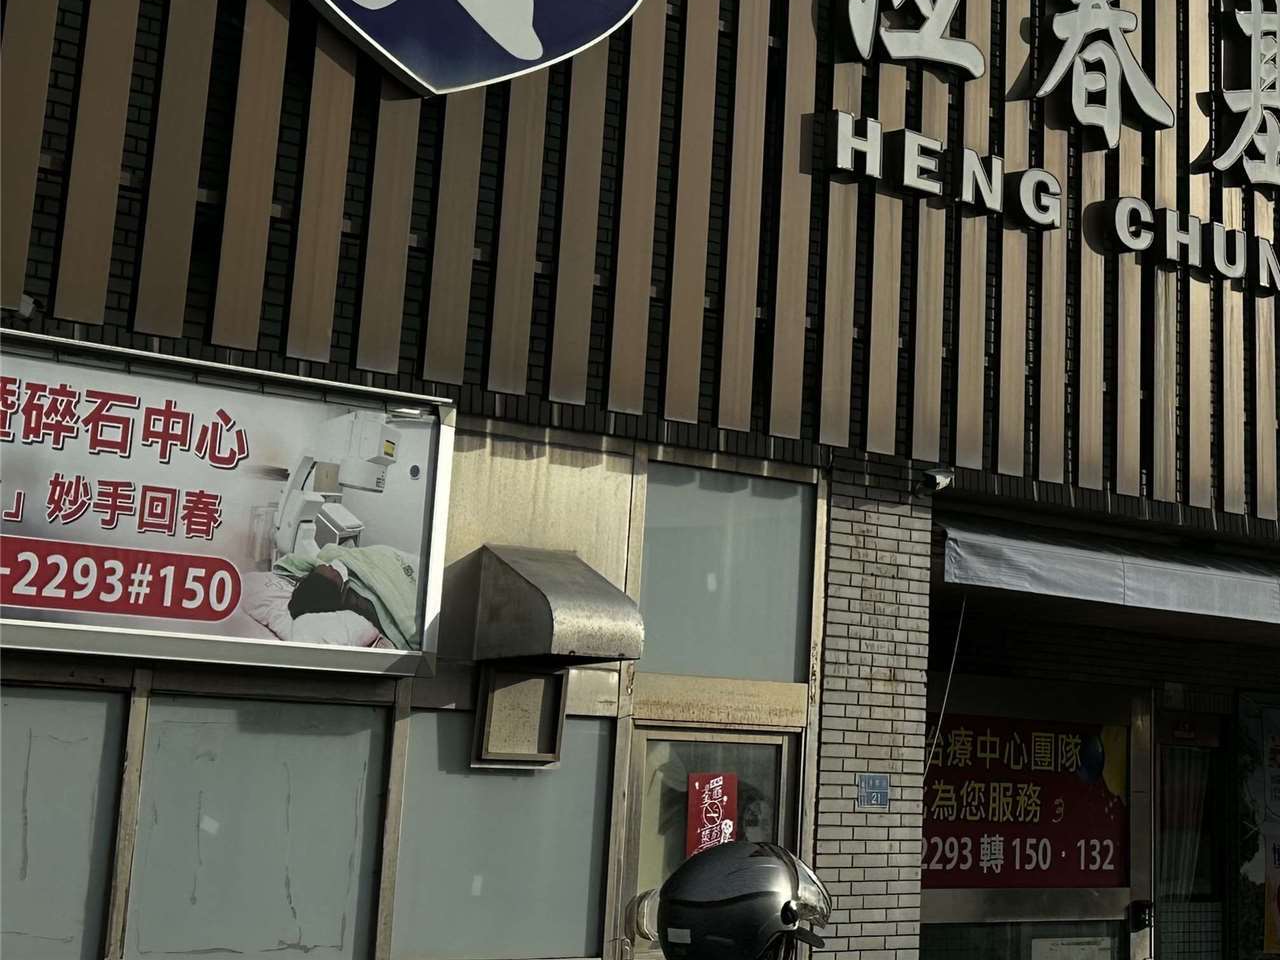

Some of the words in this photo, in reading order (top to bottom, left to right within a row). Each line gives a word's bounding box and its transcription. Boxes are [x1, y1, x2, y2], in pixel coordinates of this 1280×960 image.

[836, 110, 1062, 228] HENG
[924, 779, 1041, 823] 為您服務
[979, 833, 1004, 873] 轉
[1012, 837, 1050, 871] 150
[1077, 839, 1115, 871] 132
